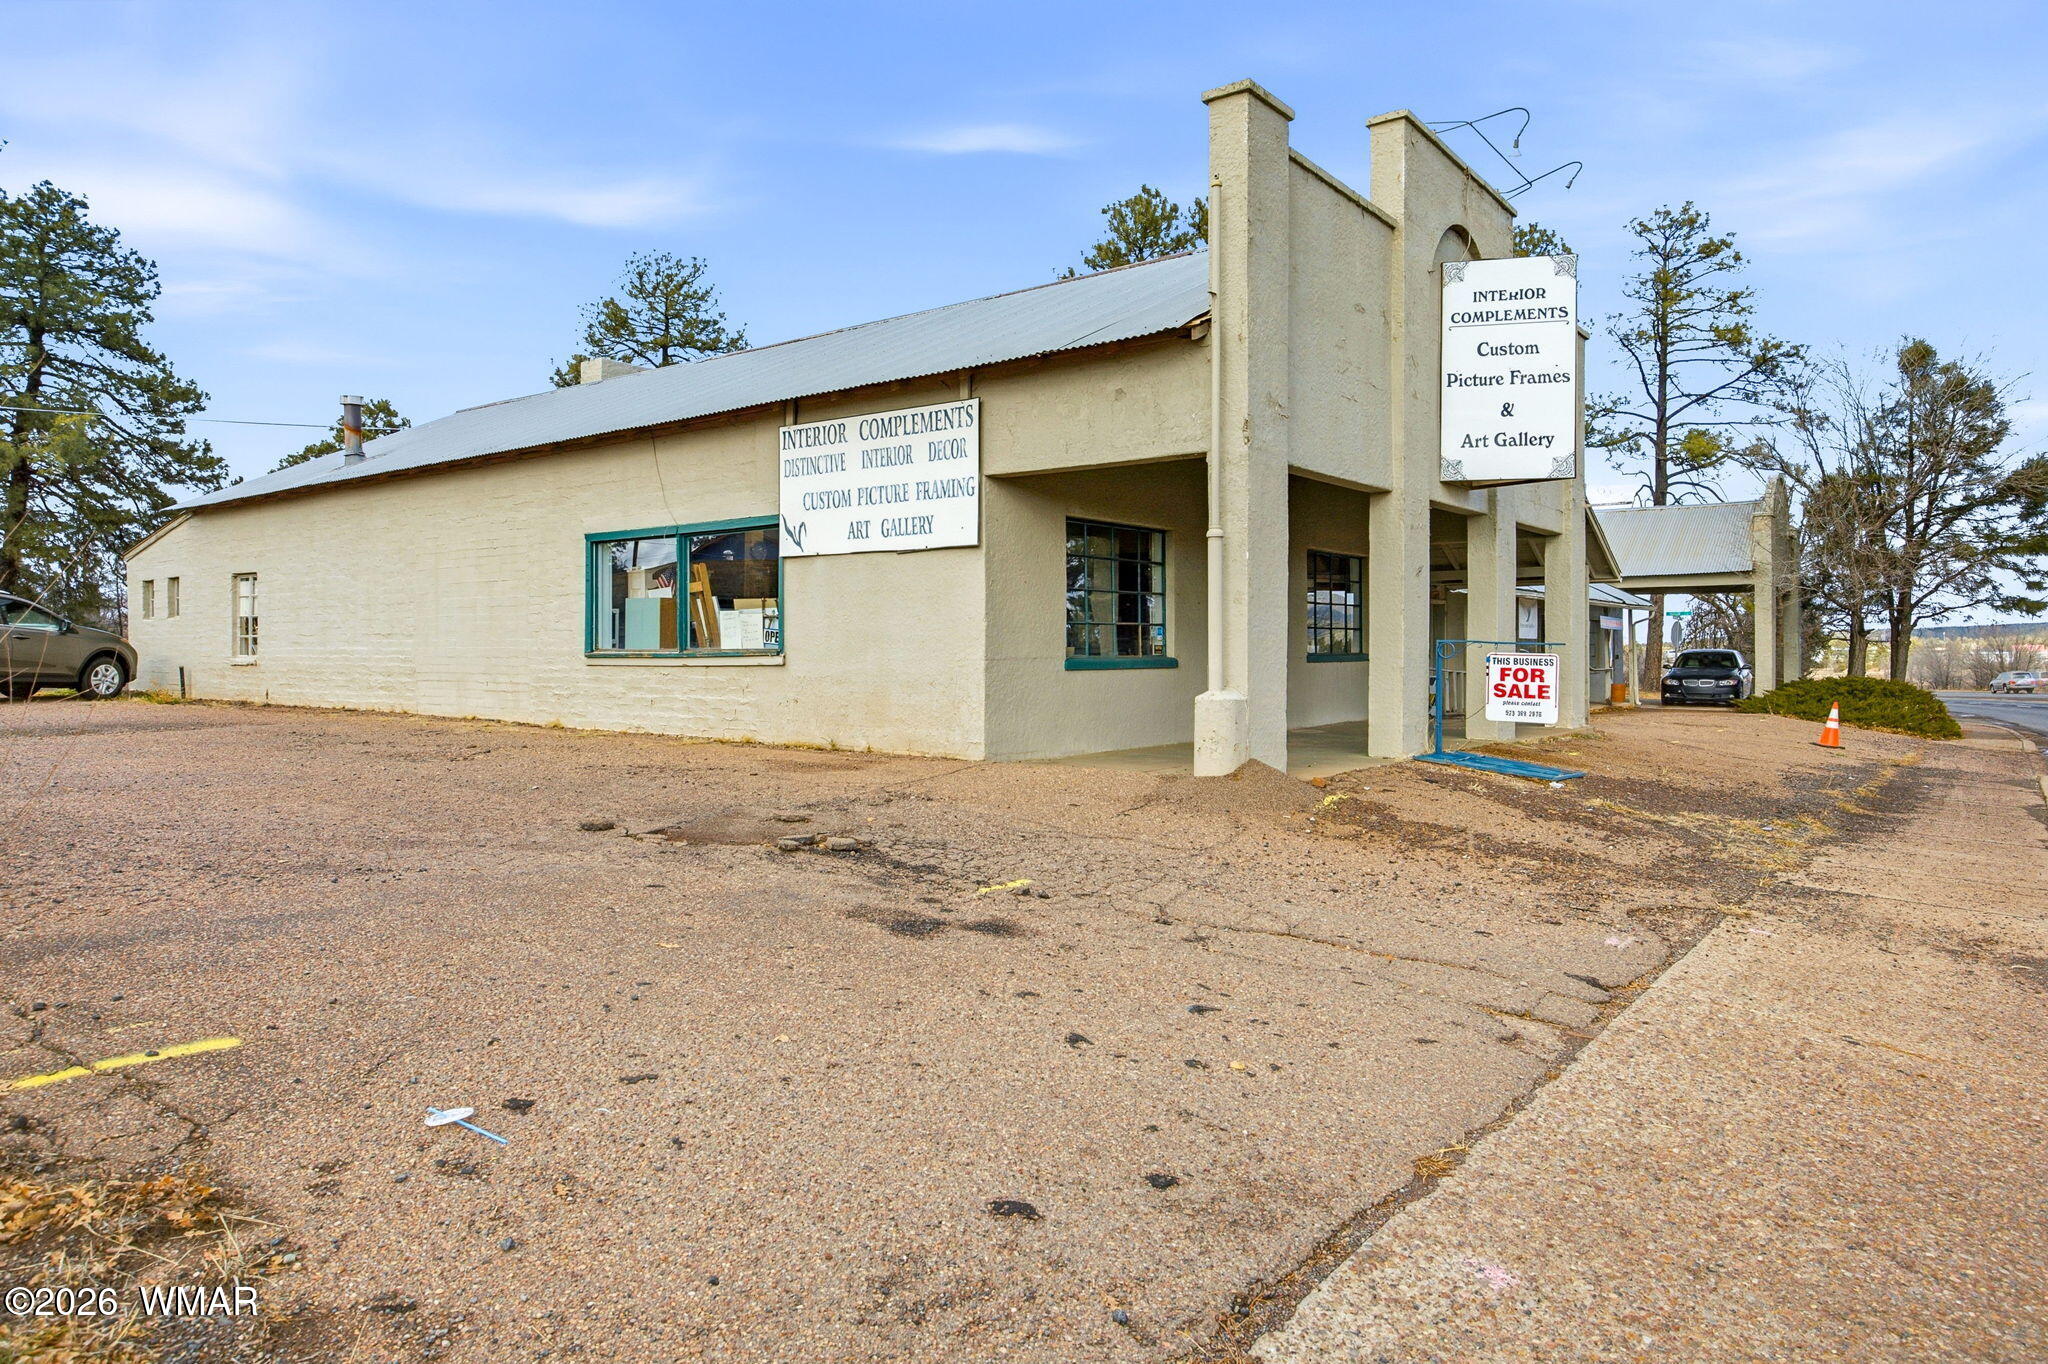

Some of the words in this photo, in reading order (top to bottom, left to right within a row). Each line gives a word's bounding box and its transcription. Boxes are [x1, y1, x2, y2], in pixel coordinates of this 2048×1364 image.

[1473, 287, 1546, 303] INTERIOR
[1451, 307, 1569, 323] COMPLEMENTS
[1477, 341, 1540, 357] Custom
[1446, 373, 1504, 388] Picture
[1509, 369, 1571, 385] Frames
[1500, 402, 1514, 417] &
[782, 422, 848, 450] INTERIOR
[859, 404, 974, 441] COMPLEMENTS
[1460, 433, 1489, 449] Art
[1494, 431, 1555, 448] Gallery
[784, 452, 846, 478] DISTINCTIVE
[861, 444, 914, 469] INTERIOR
[928, 437, 968, 462] DECOR
[803, 489, 852, 511] CUSTOM
[857, 484, 910, 506] PICTURE
[916, 476, 975, 501] FRAMING
[847, 520, 871, 540] ART
[881, 514, 934, 538] GALLERY
[765, 631, 779, 643] OPE
[1492, 657, 1511, 665] THIS
[1513, 657, 1554, 667] BUSINESS
[1500, 667, 1545, 683] FOR
[1493, 683, 1551, 700] SALE
